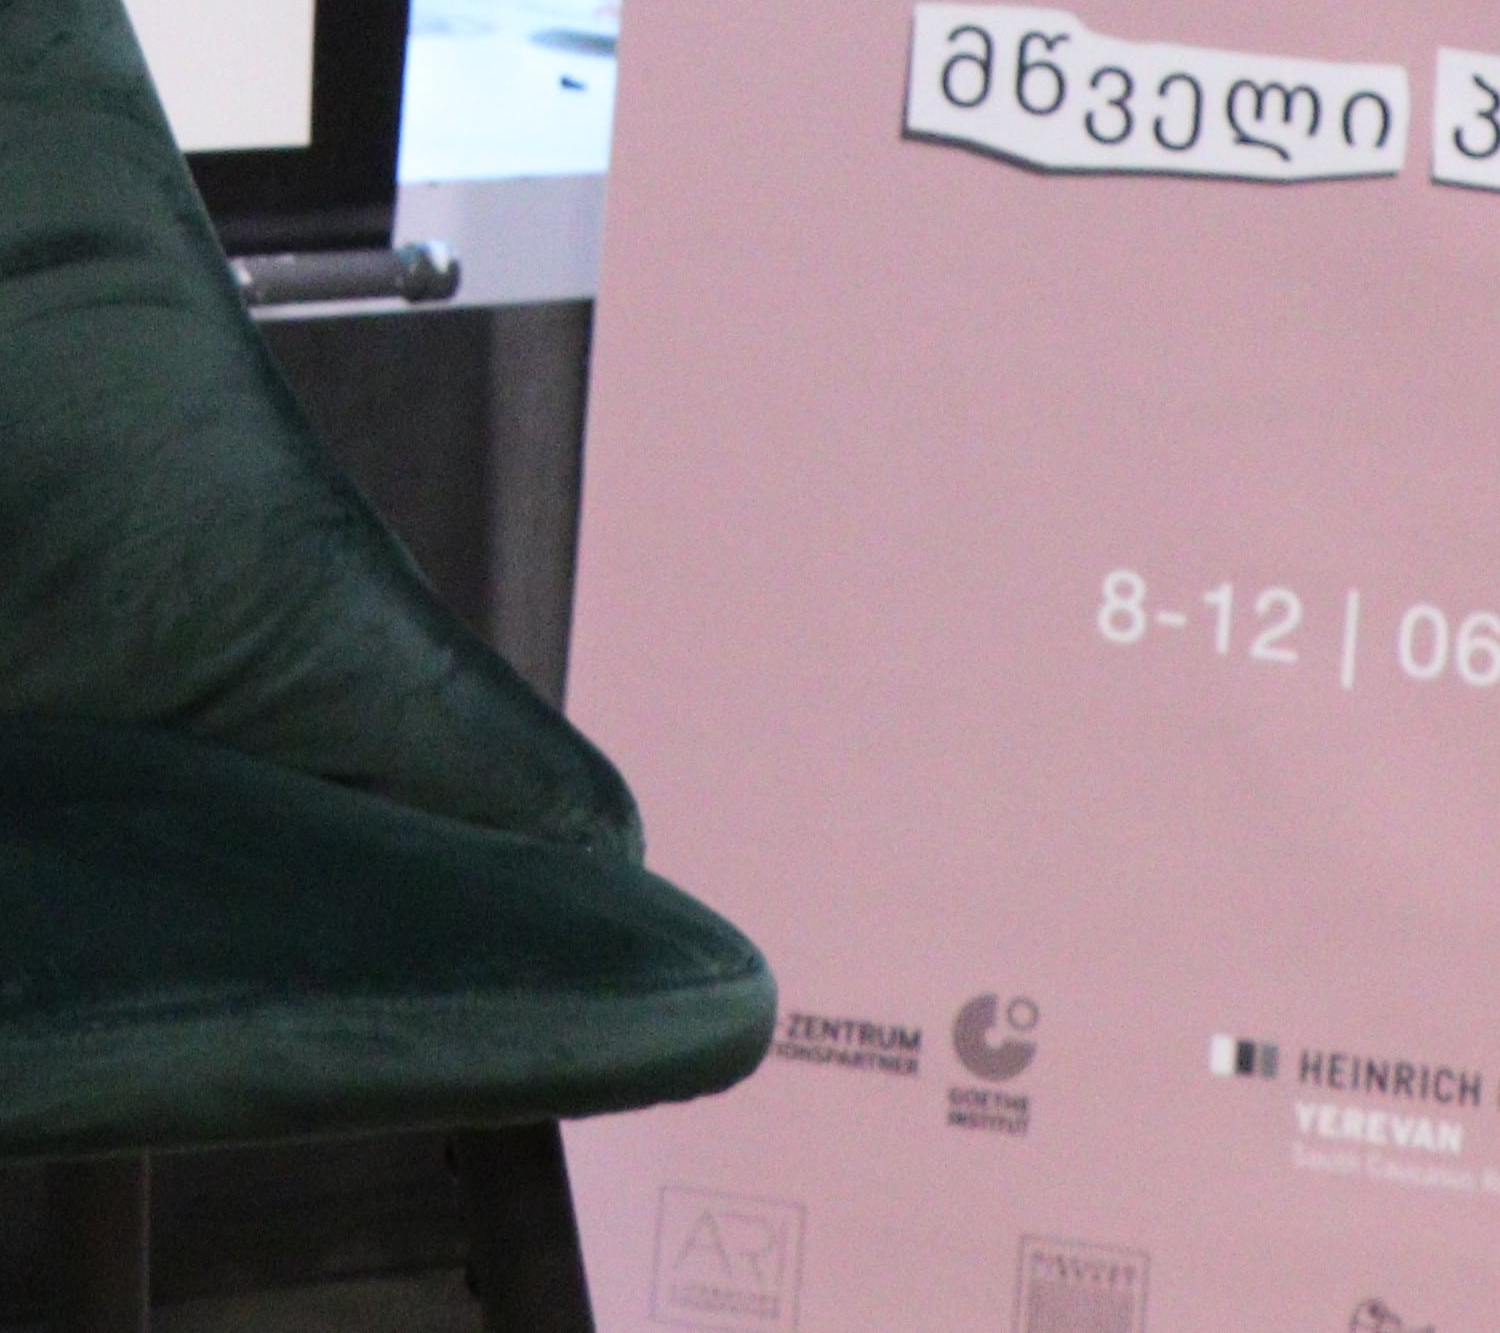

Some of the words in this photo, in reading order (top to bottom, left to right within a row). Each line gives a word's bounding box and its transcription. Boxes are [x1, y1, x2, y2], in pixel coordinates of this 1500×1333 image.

[939, 24, 1393, 163] მწველი
[1097, 568, 1302, 665] 8-12
[1299, 1049, 1483, 1108] HEINRICH
[1295, 1100, 1465, 1157] YEREVAN
